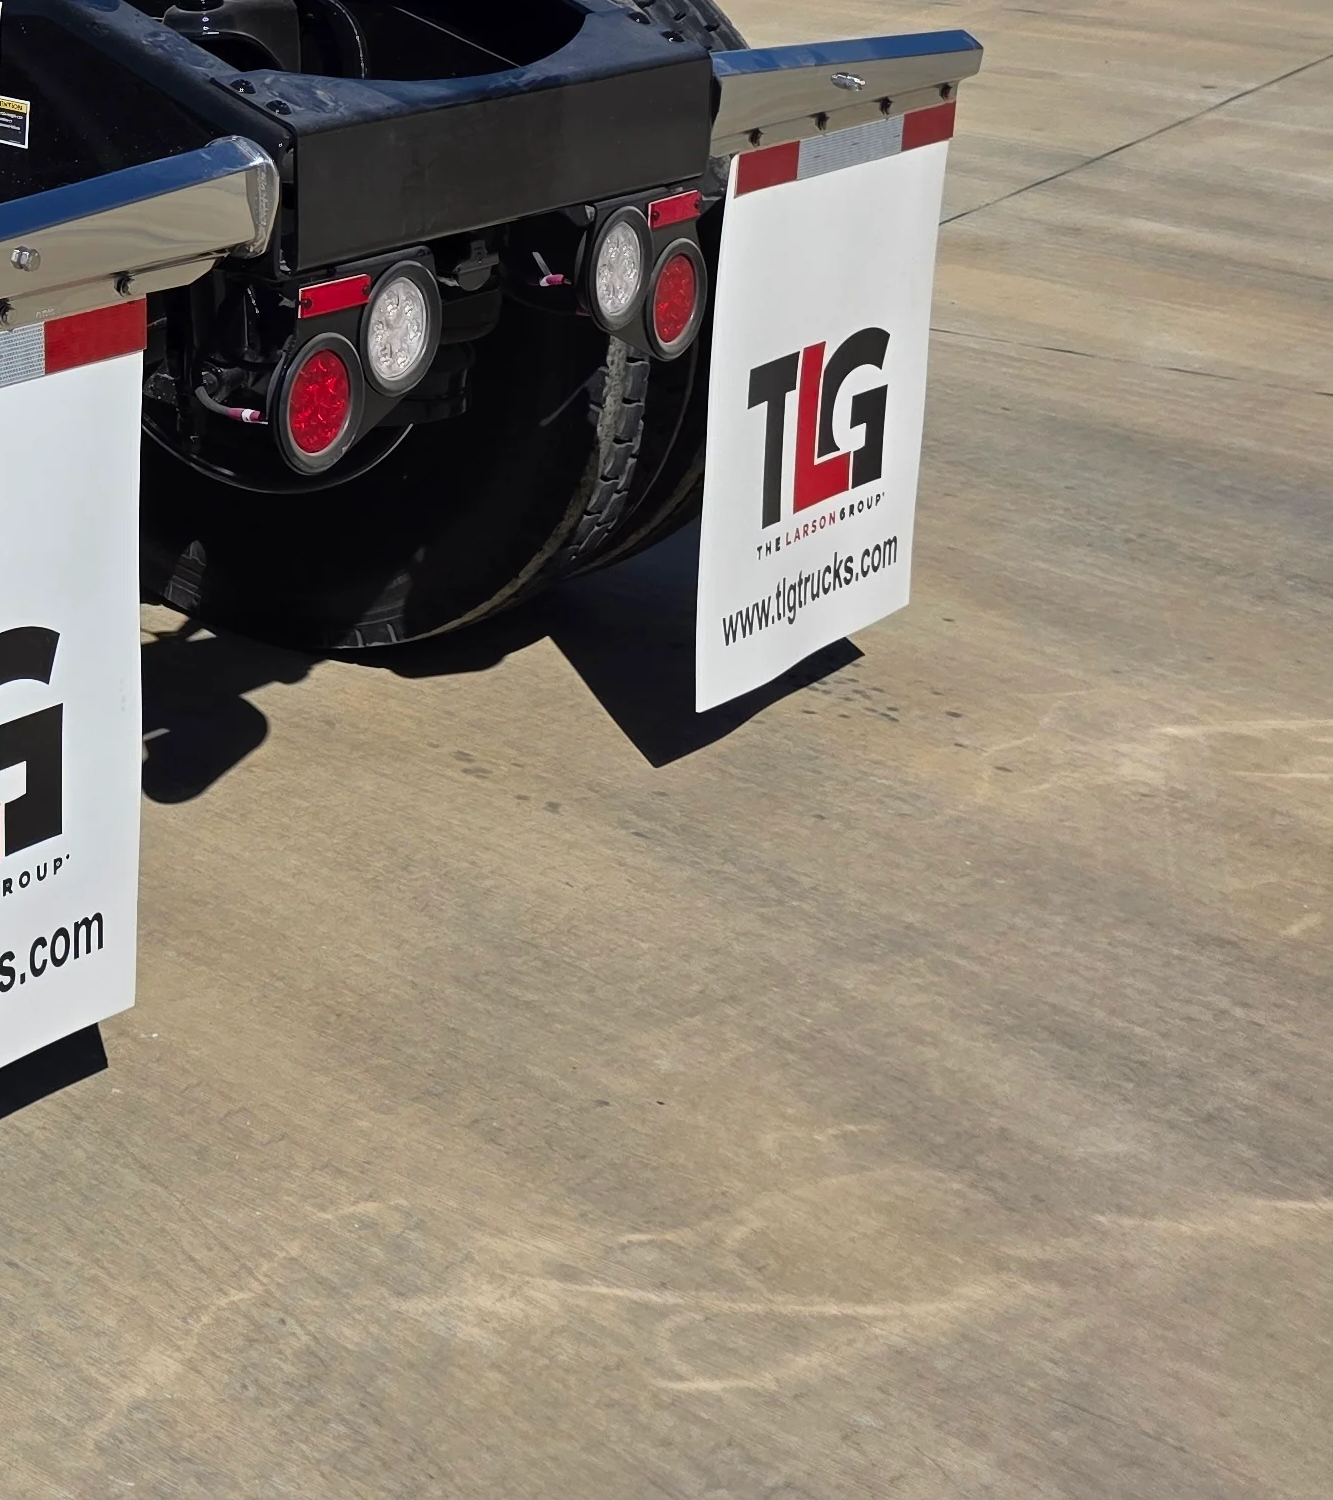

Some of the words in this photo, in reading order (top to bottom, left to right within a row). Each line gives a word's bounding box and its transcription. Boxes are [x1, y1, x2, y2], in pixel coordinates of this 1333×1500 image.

[748, 327, 891, 529] TLG
[722, 535, 898, 647] www.tlgtrucks.com
[757, 537, 781, 560] THE
